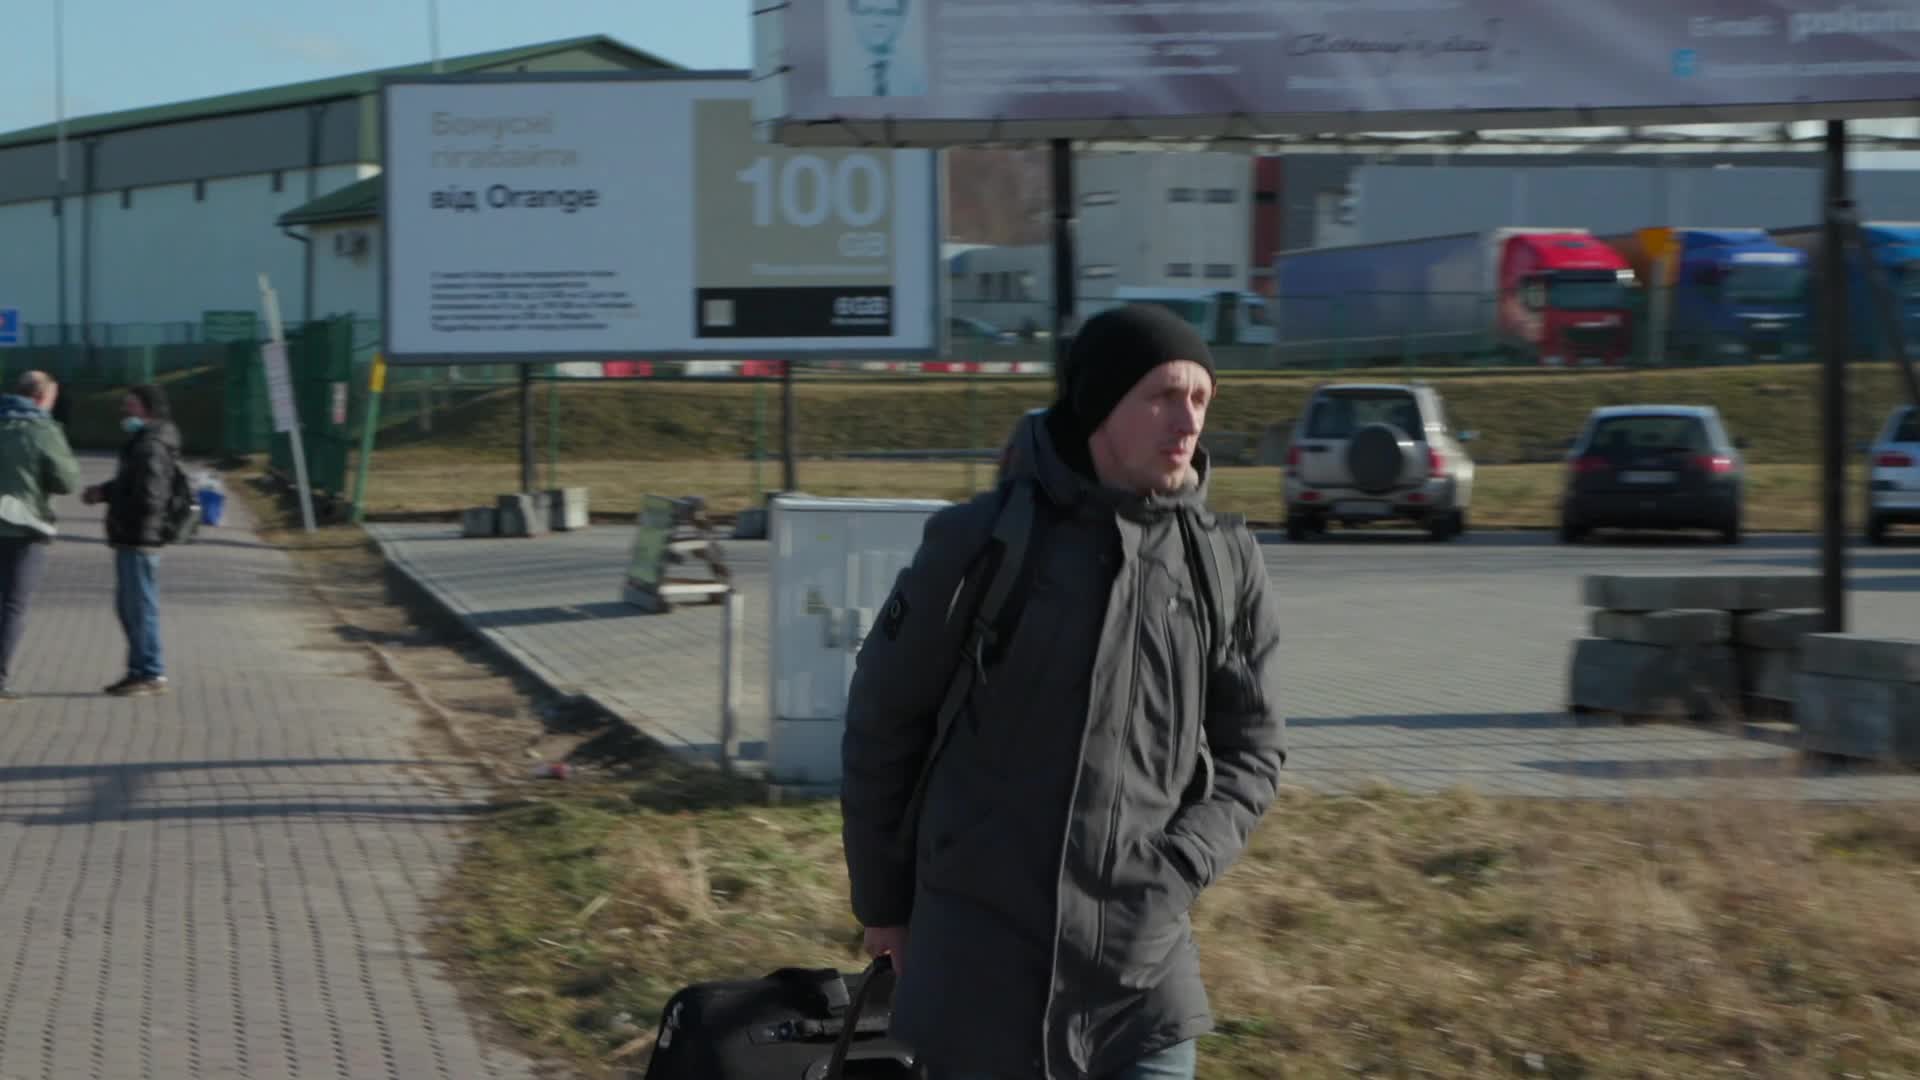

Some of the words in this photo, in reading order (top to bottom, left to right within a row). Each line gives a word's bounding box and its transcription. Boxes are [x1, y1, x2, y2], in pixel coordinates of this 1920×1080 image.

[430, 184, 480, 213] від
[485, 183, 600, 214] Orange
[735, 153, 887, 228] 100
